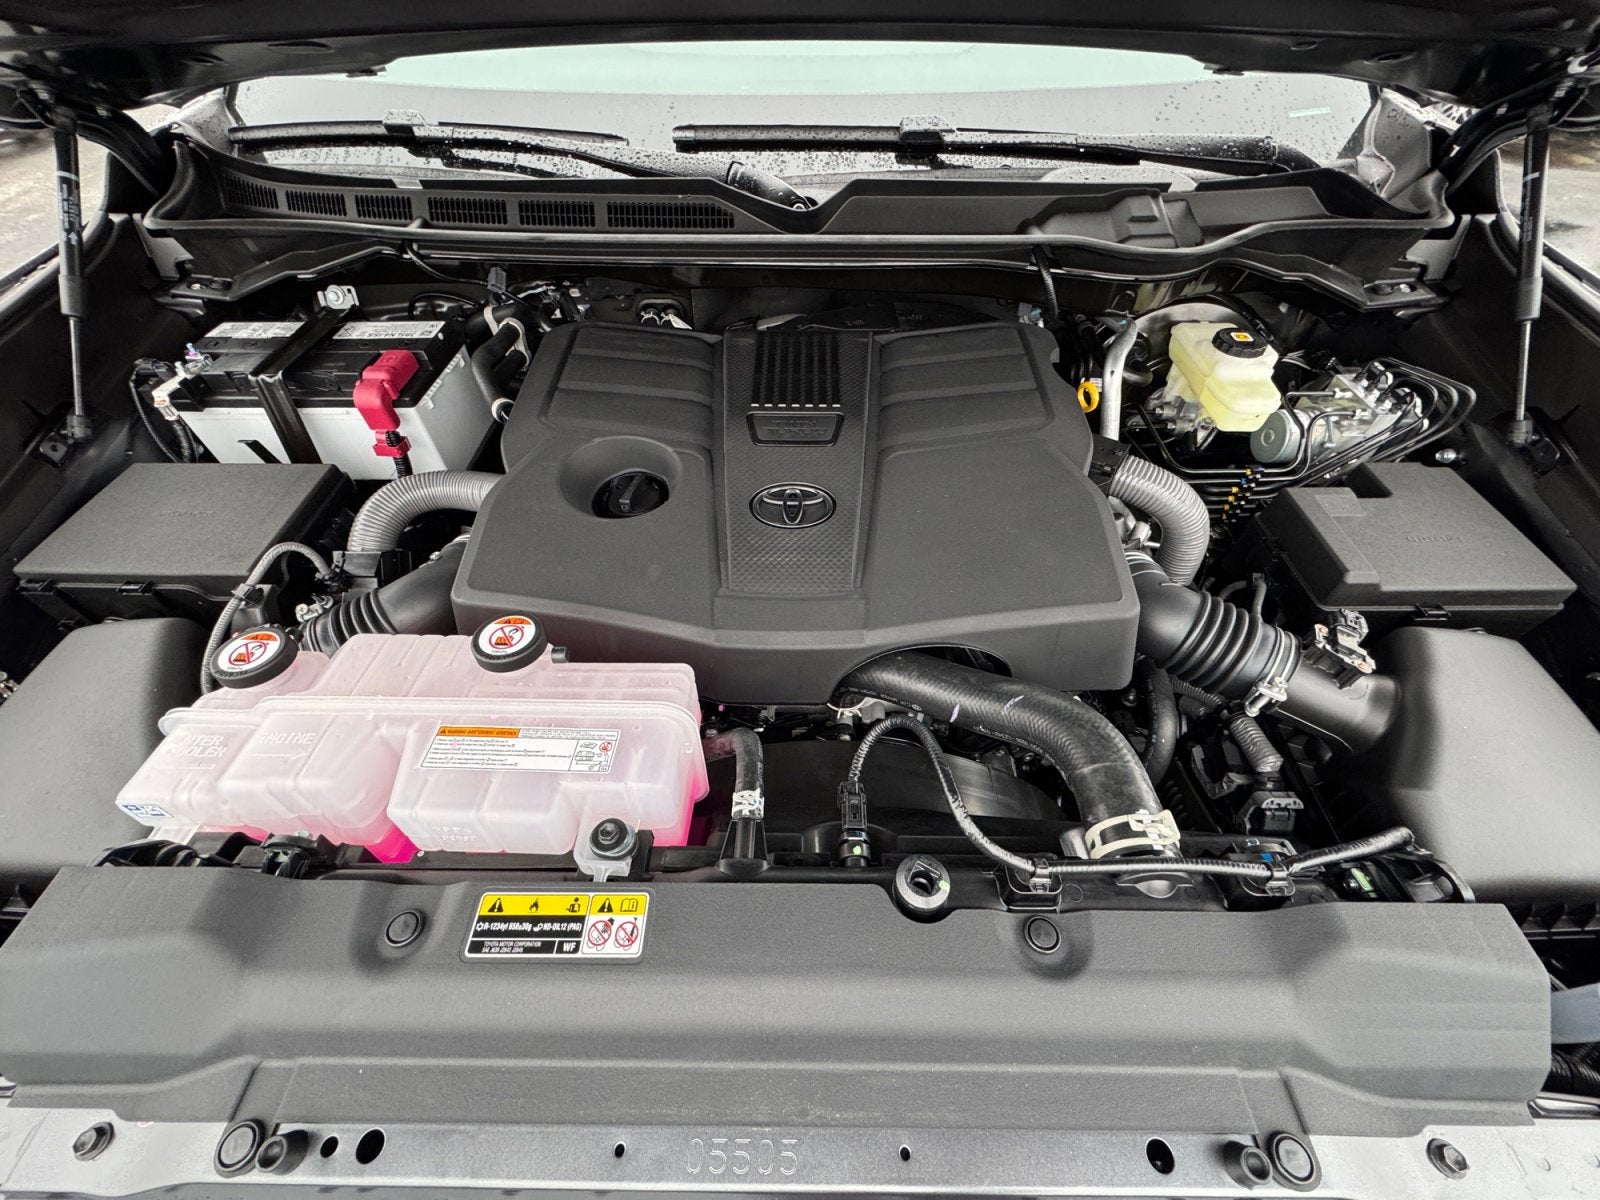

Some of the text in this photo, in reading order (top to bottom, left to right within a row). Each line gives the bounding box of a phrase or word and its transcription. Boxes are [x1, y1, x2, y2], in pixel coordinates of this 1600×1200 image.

[260, 732, 316, 744] ENGINE
[563, 942, 577, 952] WF
[686, 1138, 799, 1176] 05505
